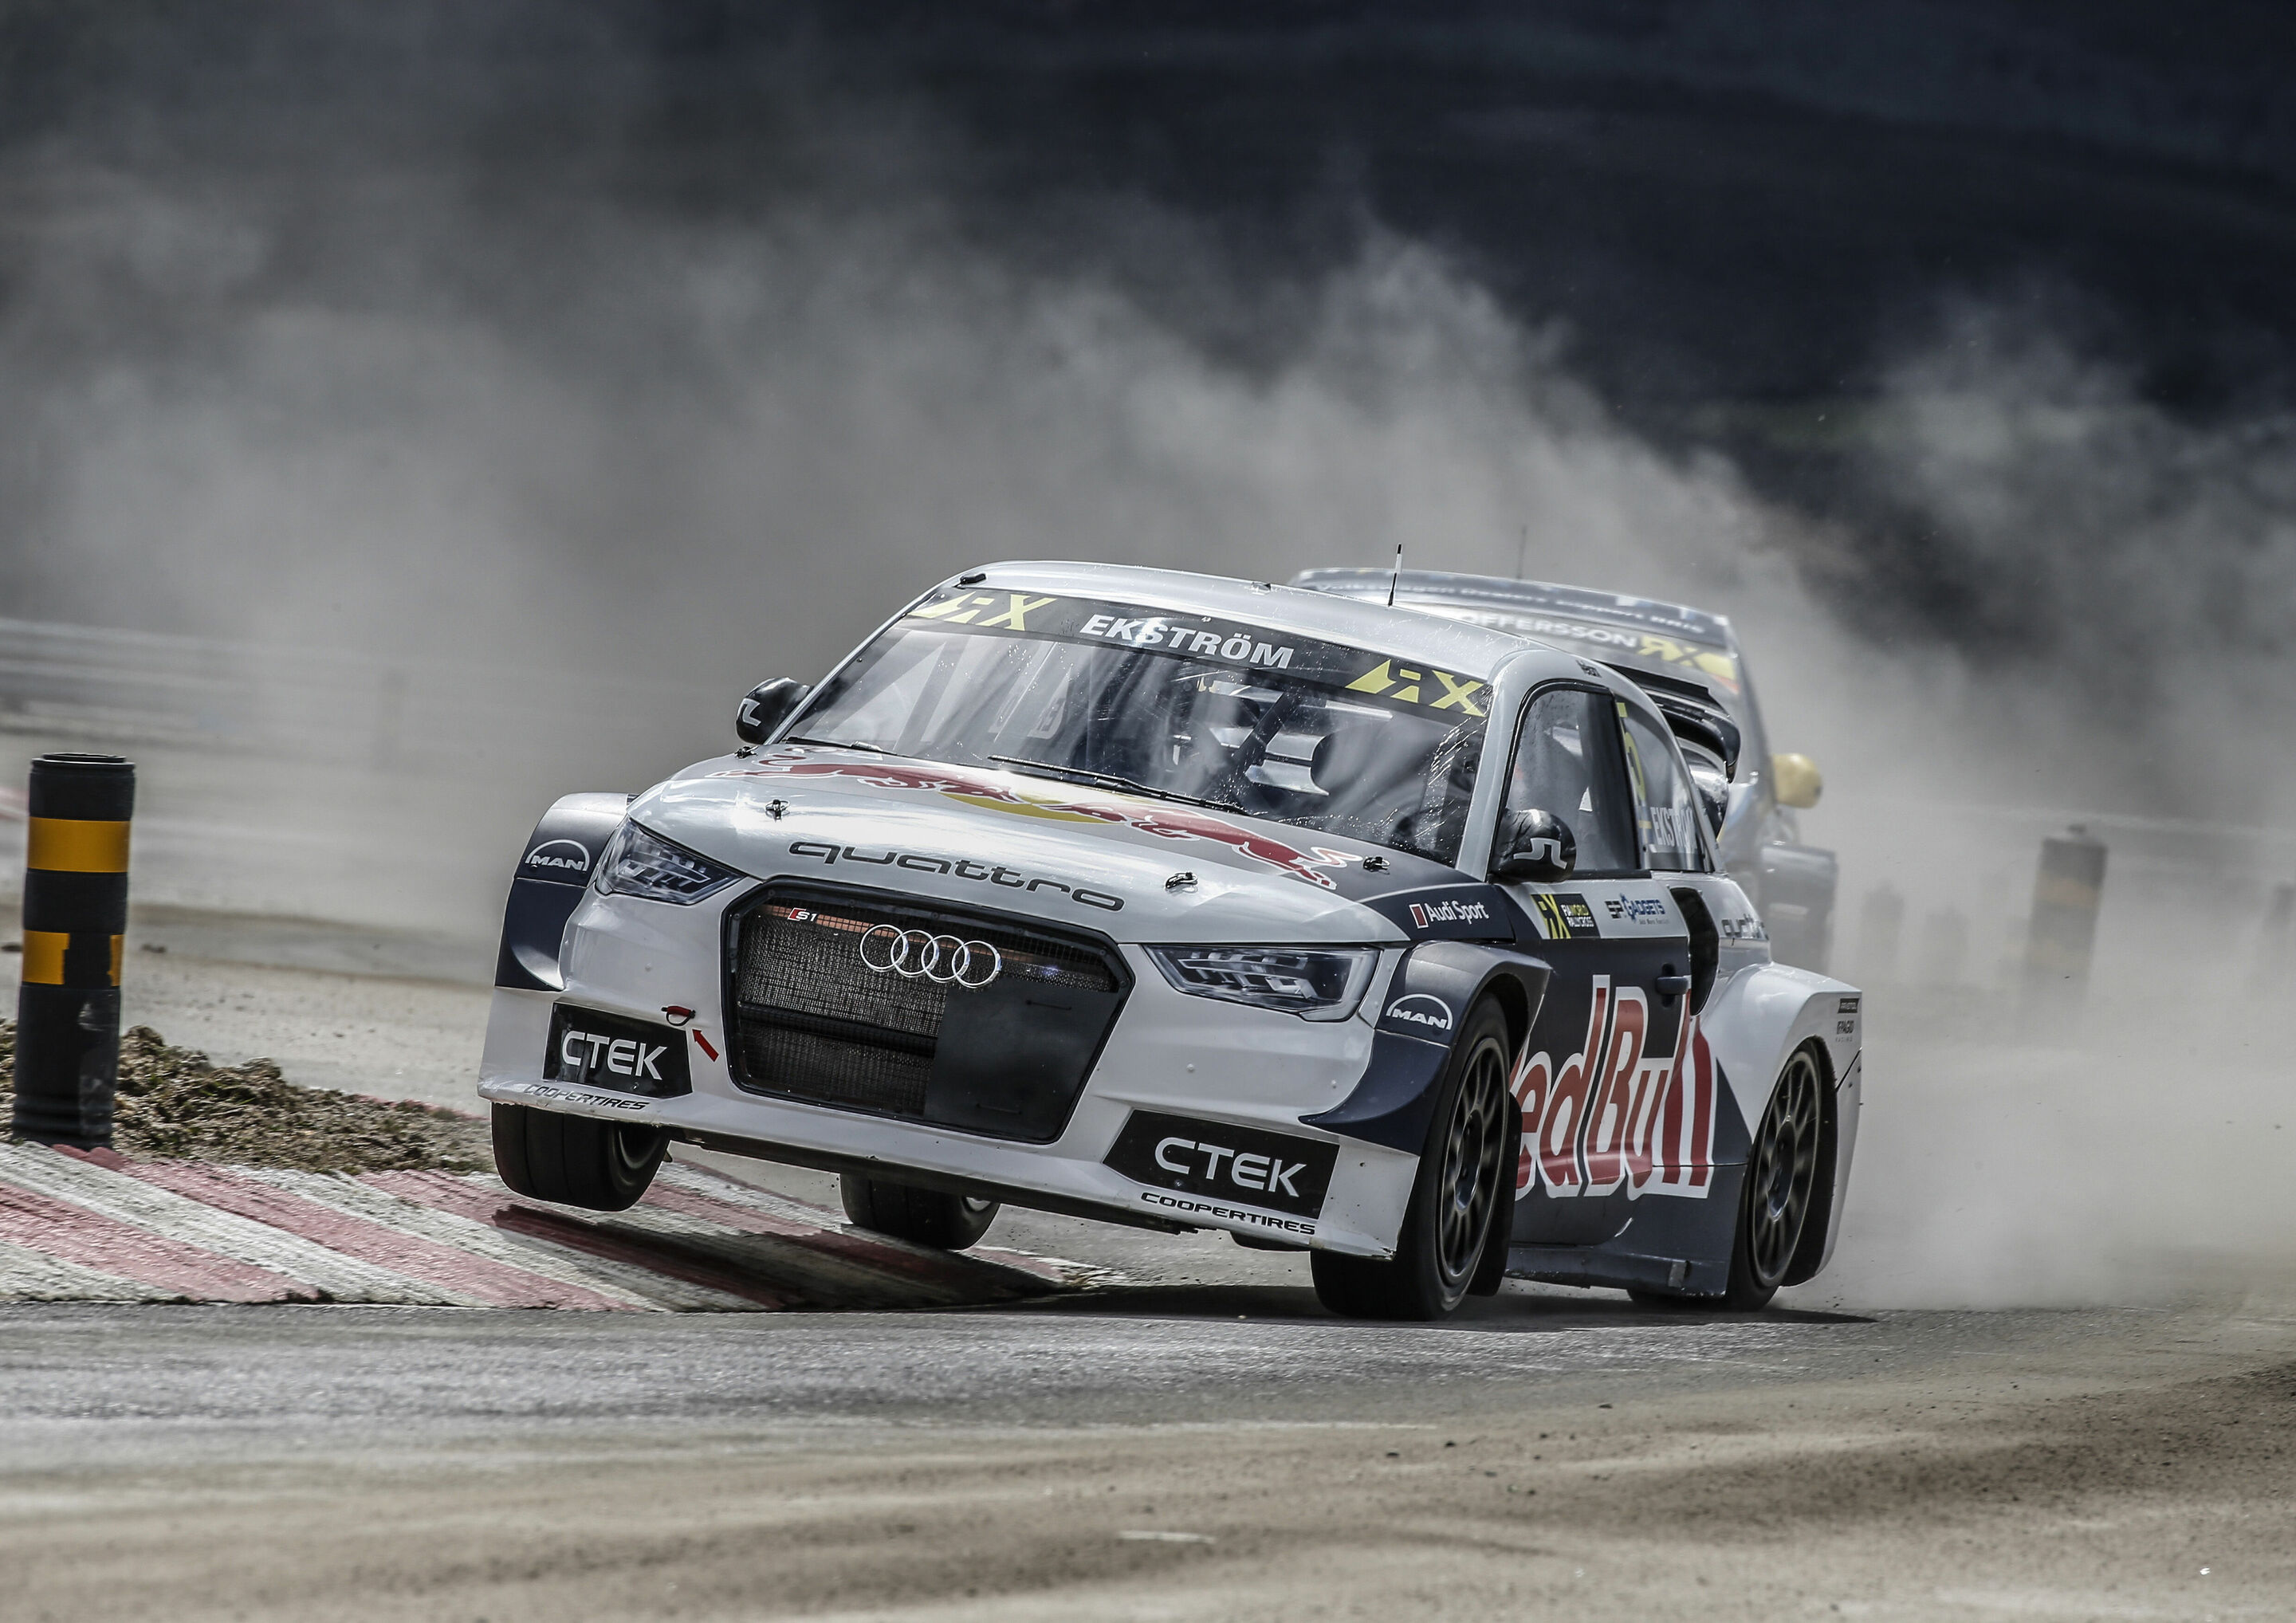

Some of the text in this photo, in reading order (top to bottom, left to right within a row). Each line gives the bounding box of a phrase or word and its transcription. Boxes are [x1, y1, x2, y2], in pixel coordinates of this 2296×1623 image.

[1079, 614, 1295, 669] EKSTRÖM
[530, 855, 584, 871] MAN
[788, 840, 1126, 912] quattro
[795, 910, 817, 922] S1
[1424, 900, 1489, 925] Audi Sport
[1392, 1008, 1447, 1029] MAN
[562, 1030, 668, 1081] CTEK
[1512, 977, 1714, 1198] ed Bull
[1154, 1136, 1307, 1197] CTEK
[1141, 1192, 1315, 1236] COOPERTIRES
